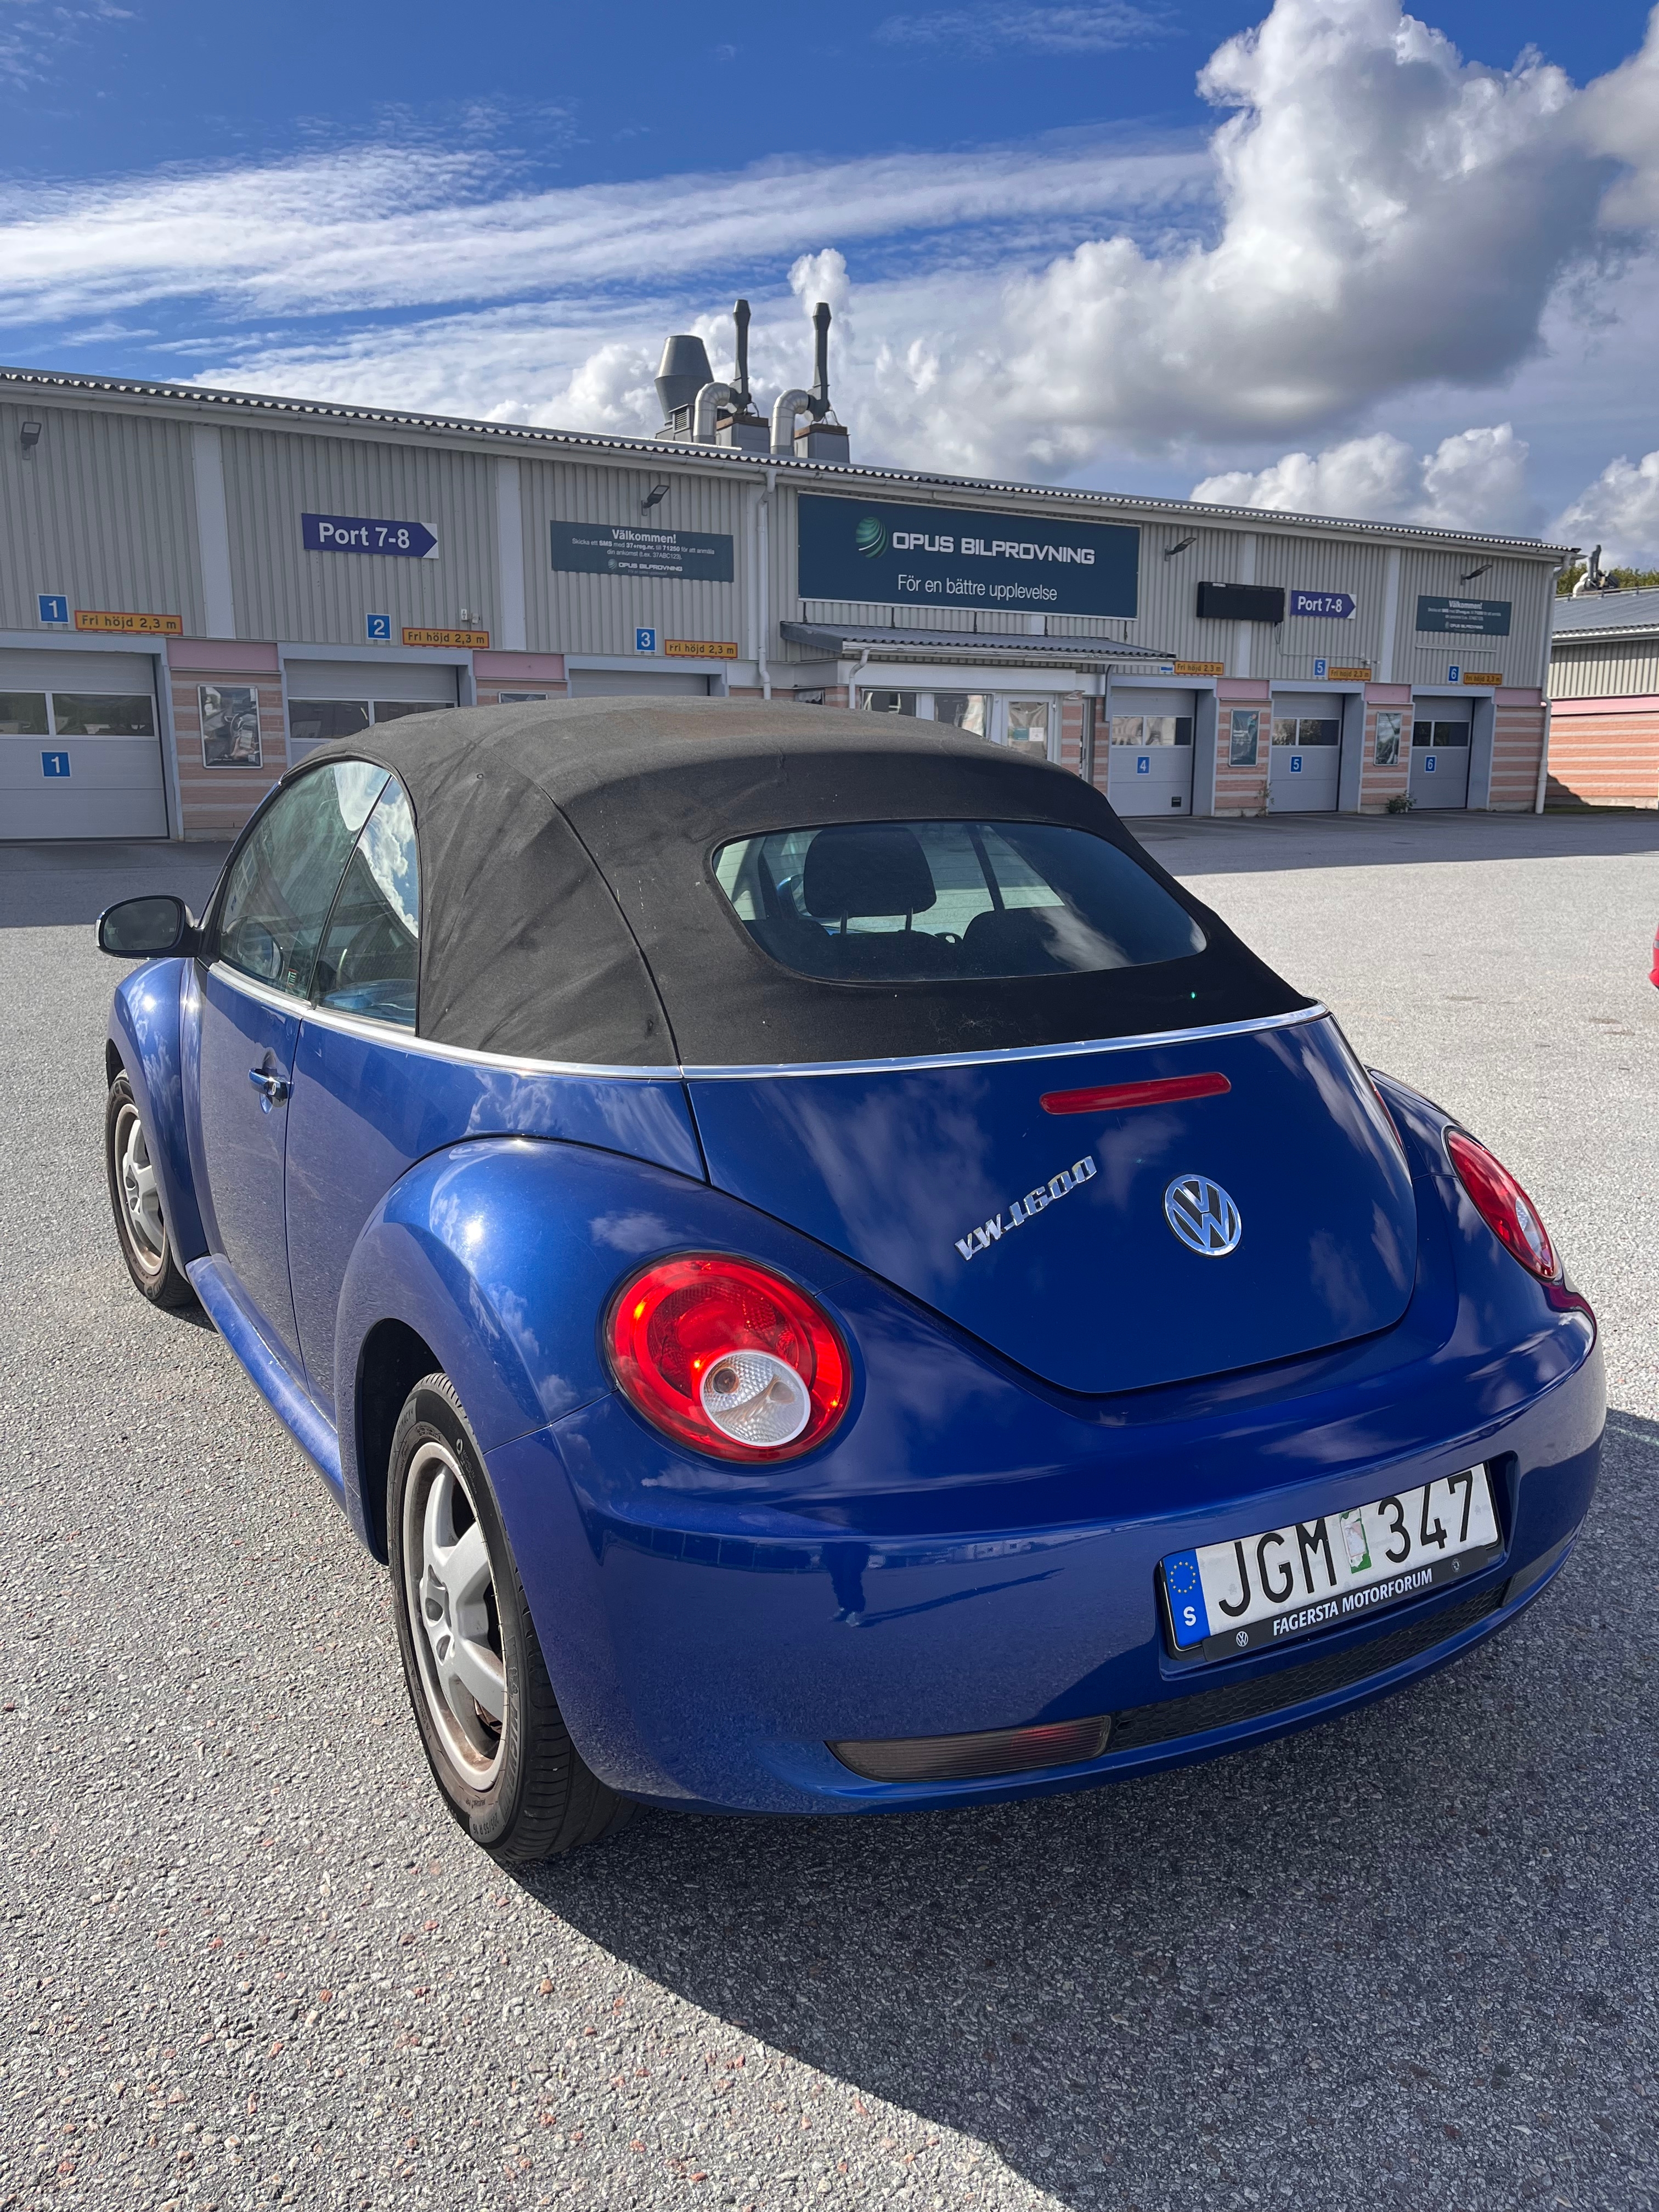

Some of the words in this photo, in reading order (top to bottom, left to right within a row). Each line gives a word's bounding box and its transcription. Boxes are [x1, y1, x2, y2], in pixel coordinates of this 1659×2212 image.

[319, 522, 369, 546] Port
[375, 527, 410, 549] 7-8
[612, 529, 676, 544] Välkommen!
[893, 532, 954, 553] OPUS
[961, 538, 1095, 565] BILPROVNING
[898, 574, 922, 592] För
[925, 580, 942, 593] en
[946, 578, 985, 596] bättre
[989, 583, 1058, 601] upplevelse
[48, 600, 58, 618] 1
[1297, 595, 1322, 611] Port
[1325, 598, 1342, 613] 7-8
[82, 615, 98, 625] Fri
[105, 616, 133, 629] höjd
[140, 618, 160, 630] 2,3
[374, 619, 385, 635] 2
[408, 631, 421, 641] Fri
[427, 632, 449, 644] höjd
[455, 634, 471, 645] 2,3
[641, 632, 651, 647] 3
[669, 644, 681, 652] Fri
[685, 644, 705, 654] höjd
[709, 645, 723, 654] 2,3
[1317, 662, 1323, 673] 5
[1451, 668, 1457, 680] 6
[51, 756, 60, 773] 1
[1140, 760, 1147, 771] 4
[1293, 759, 1299, 770] 5
[1428, 759, 1433, 769] 6
[1008, 1155, 1097, 1227] 1600
[1164, 1173, 1242, 1256] VW
[1218, 1518, 1337, 1617] JGM
[1378, 1471, 1474, 1564] 347
[1273, 1601, 1339, 1636] FAGERSTA
[1342, 1568, 1433, 1613] MOTORFORUM
[1183, 1606, 1196, 1626] S
